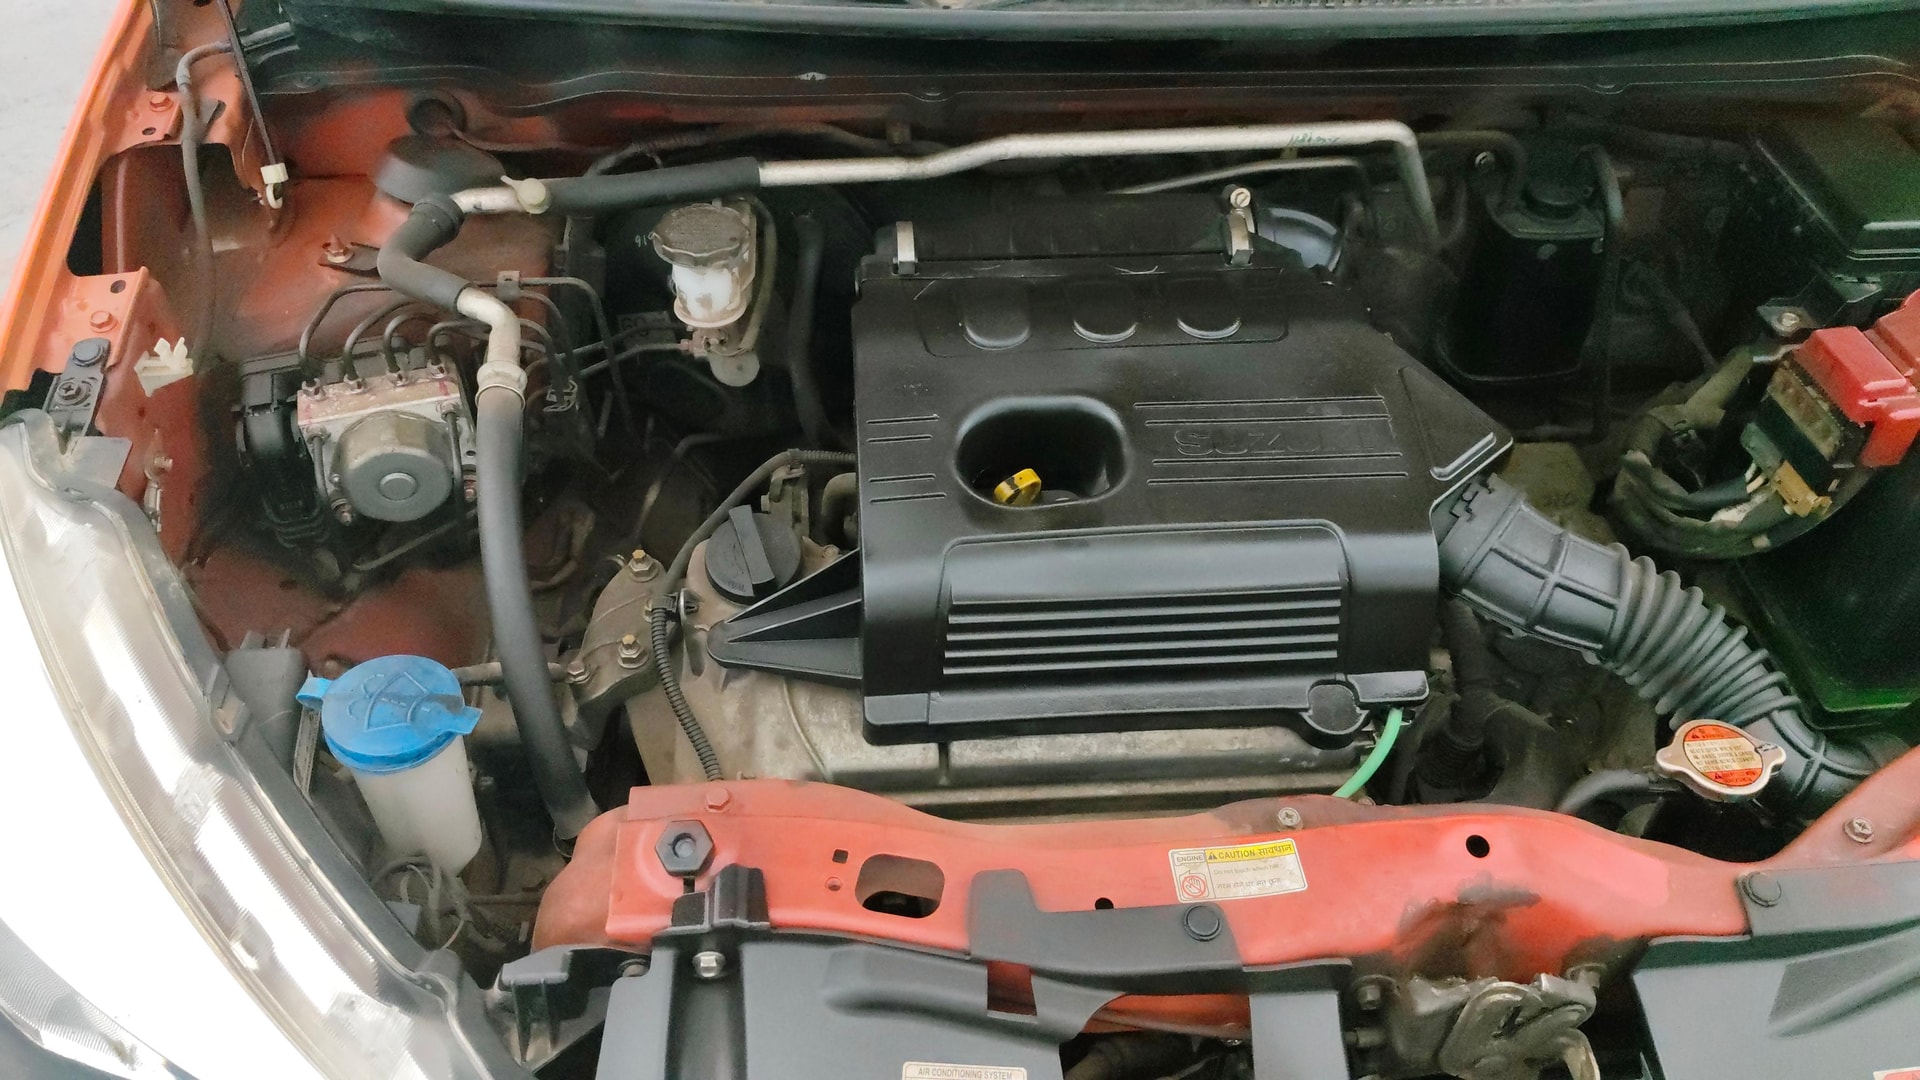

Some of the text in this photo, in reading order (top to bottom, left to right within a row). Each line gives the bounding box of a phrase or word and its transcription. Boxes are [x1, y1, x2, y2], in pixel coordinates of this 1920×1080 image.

[1176, 854, 1204, 862] ENGINE
[1218, 848, 1256, 859] CAUTION
[918, 1067, 1013, 1080] AIR CONDITIONING SYSTEM
